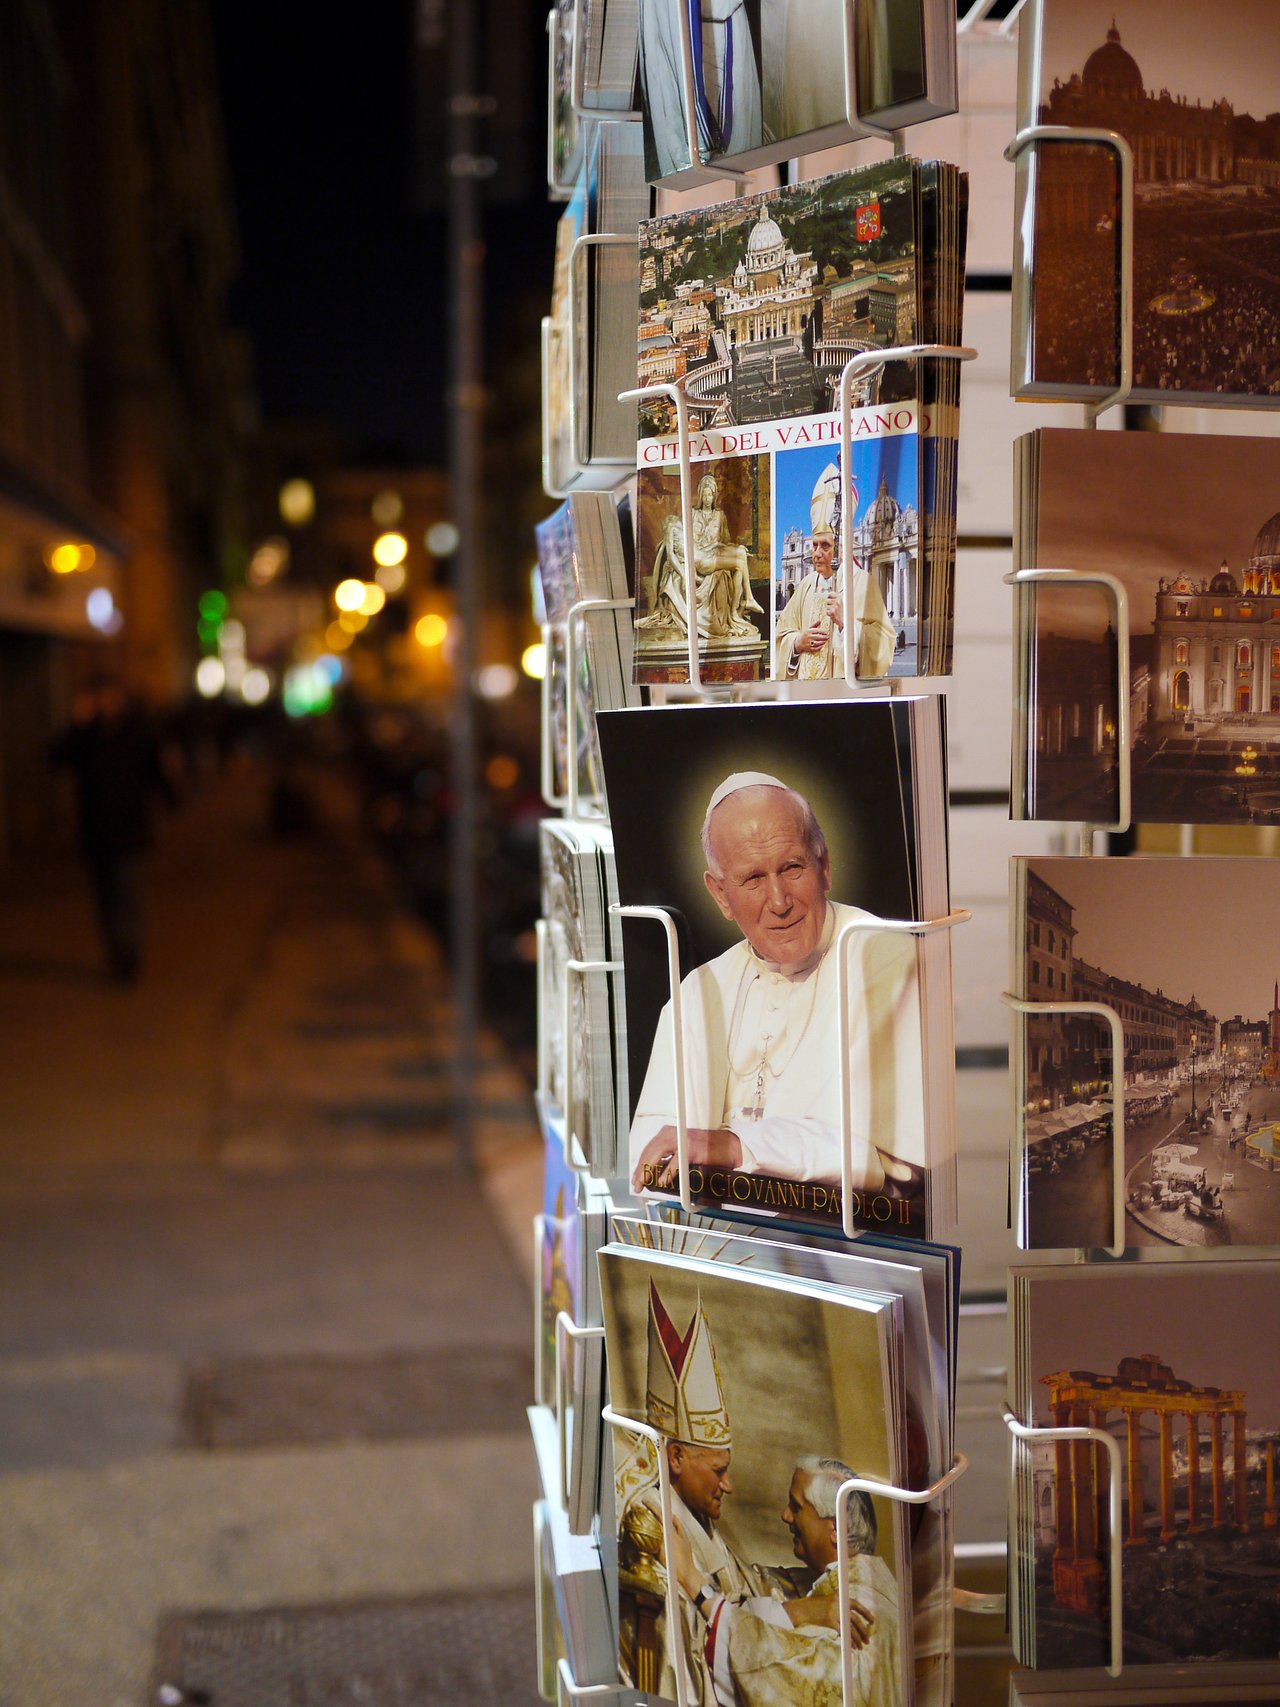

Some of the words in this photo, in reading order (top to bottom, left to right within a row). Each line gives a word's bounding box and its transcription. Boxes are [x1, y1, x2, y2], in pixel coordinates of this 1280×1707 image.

[721, 431, 769, 454] DEL
[642, 1163, 705, 1193] BEAO
[709, 1173, 806, 1209] GIOVANNI
[898, 1199, 910, 1225] II
